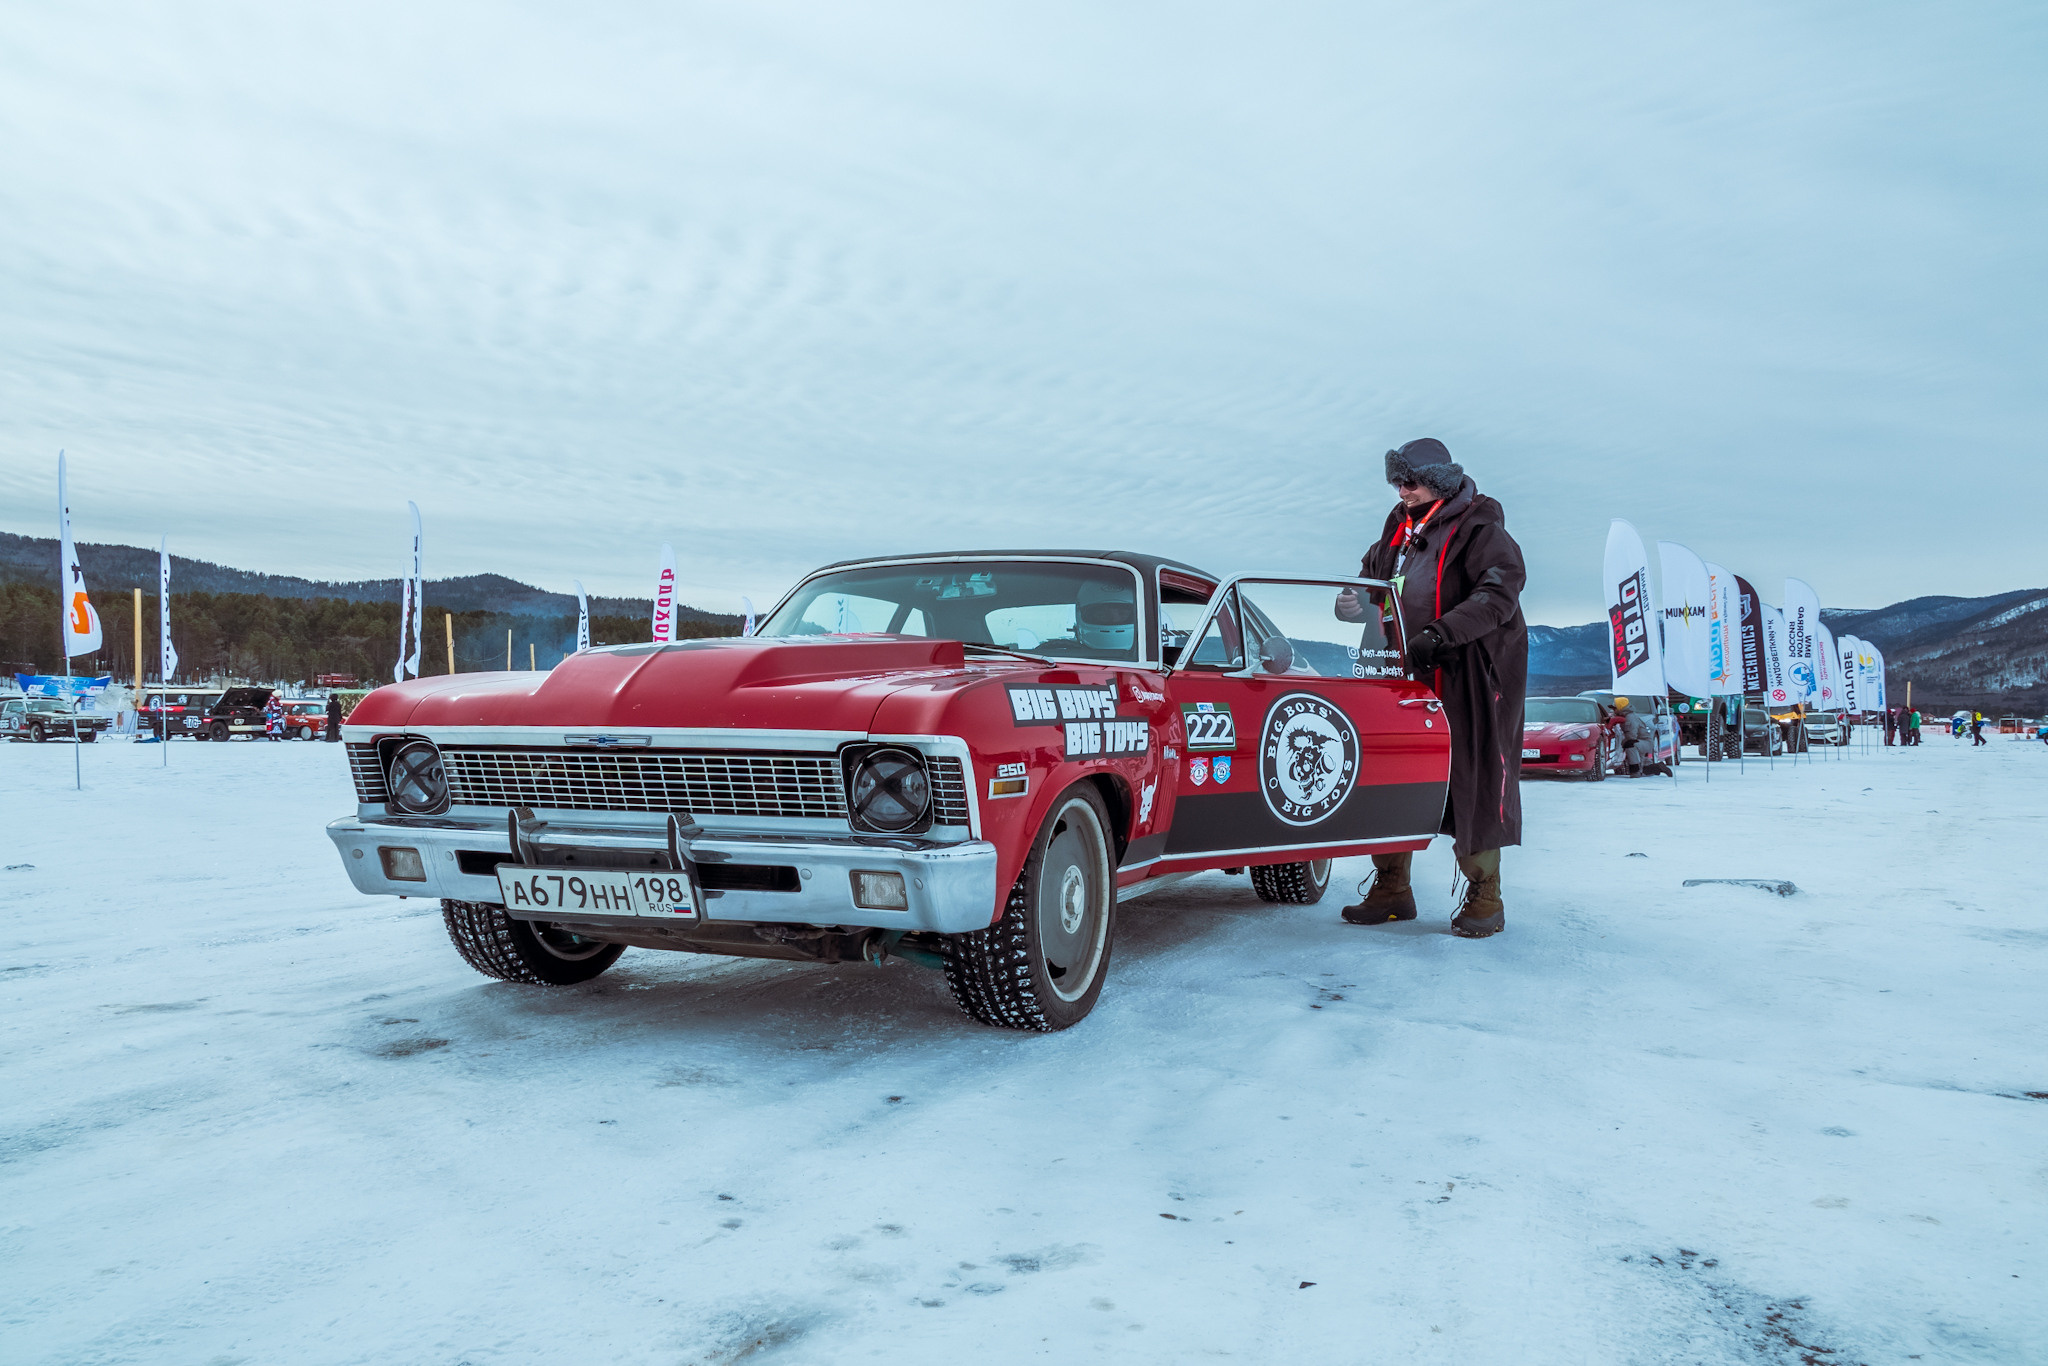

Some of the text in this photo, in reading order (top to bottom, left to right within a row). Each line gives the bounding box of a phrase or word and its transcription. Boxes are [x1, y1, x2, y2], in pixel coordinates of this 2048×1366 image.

[1742, 625, 1760, 690] MECHANICS
[1009, 684, 1118, 720] BIG BOYS'
[1065, 722, 1148, 756] BIG TOYS
[1187, 714, 1233, 743] 222
[1266, 720, 1284, 759] BIG
[998, 762, 1026, 778] 250
[1282, 760, 1353, 817] BIG TOYS
[634, 877, 684, 903] 198
[649, 902, 673, 912] RUS
